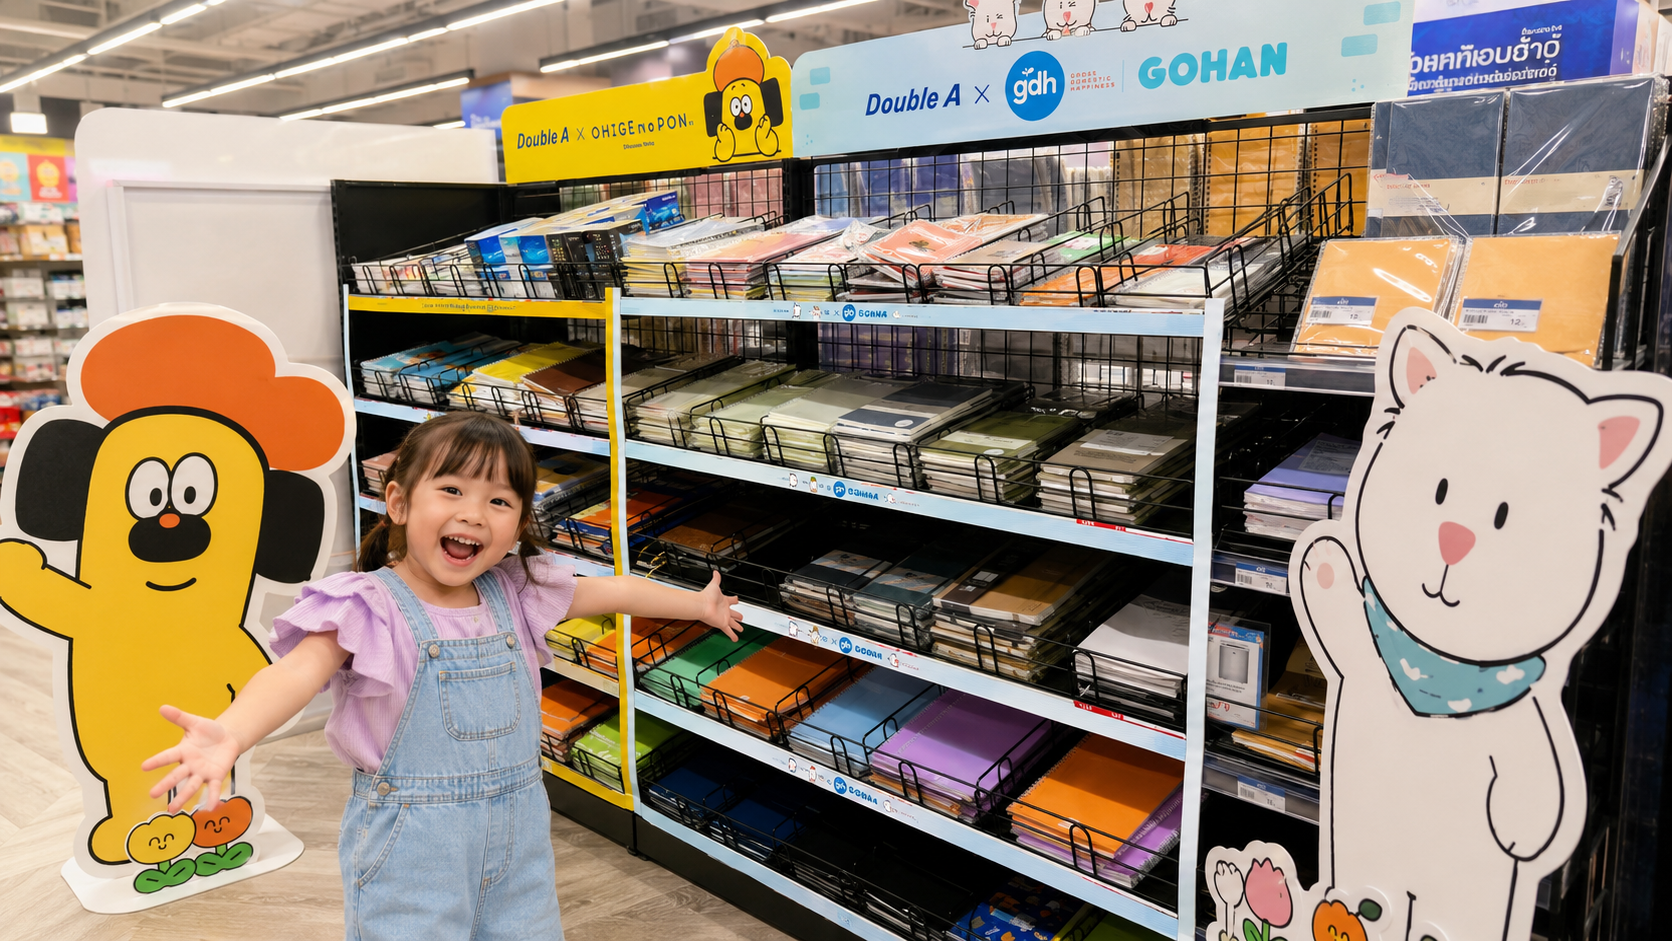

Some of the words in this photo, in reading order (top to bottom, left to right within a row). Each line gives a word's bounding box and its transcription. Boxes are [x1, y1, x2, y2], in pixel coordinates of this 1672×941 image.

[1138, 41, 1288, 90] GOHAN
[865, 88, 939, 117] Double
[942, 83, 962, 108] A
[1013, 69, 1057, 105] gdh
[1070, 82, 1115, 91] HAPPINESS
[516, 128, 558, 150] Double
[560, 127, 570, 144] A
